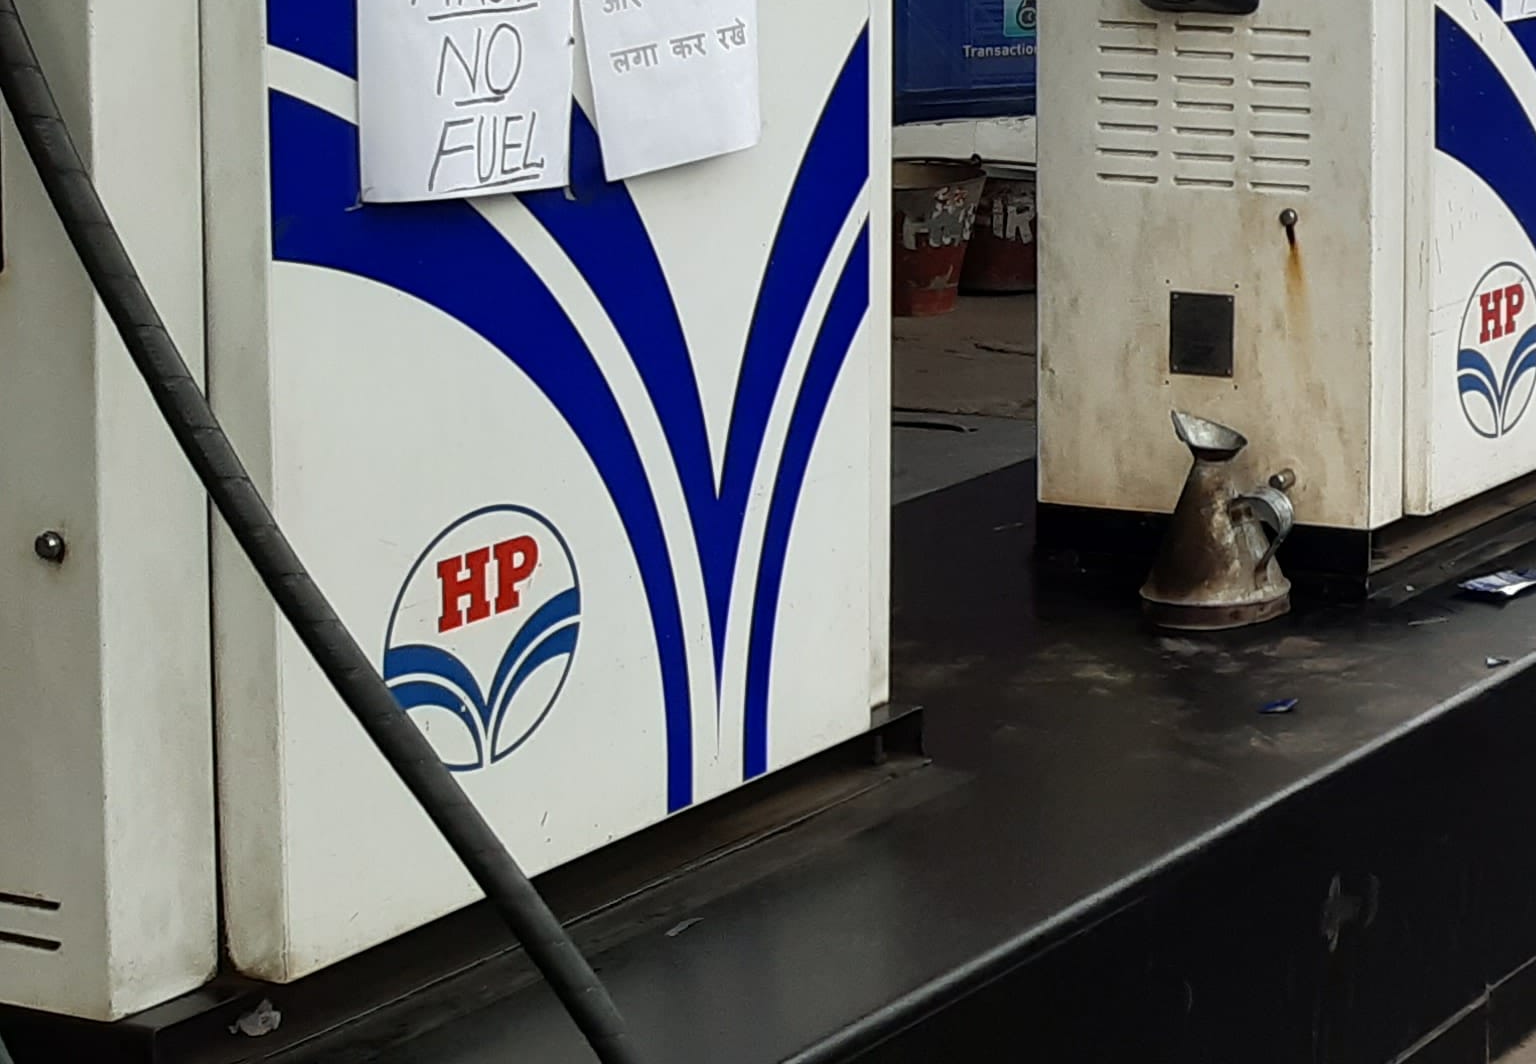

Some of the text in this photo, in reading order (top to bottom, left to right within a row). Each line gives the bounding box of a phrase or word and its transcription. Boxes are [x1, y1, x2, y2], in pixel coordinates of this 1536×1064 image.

[437, 23, 522, 96] NO
[610, 43, 659, 74] लगा
[669, 33, 706, 59] कर
[428, 112, 545, 191] FUEL
[1480, 283, 1524, 344] HP
[437, 535, 539, 633] HP
